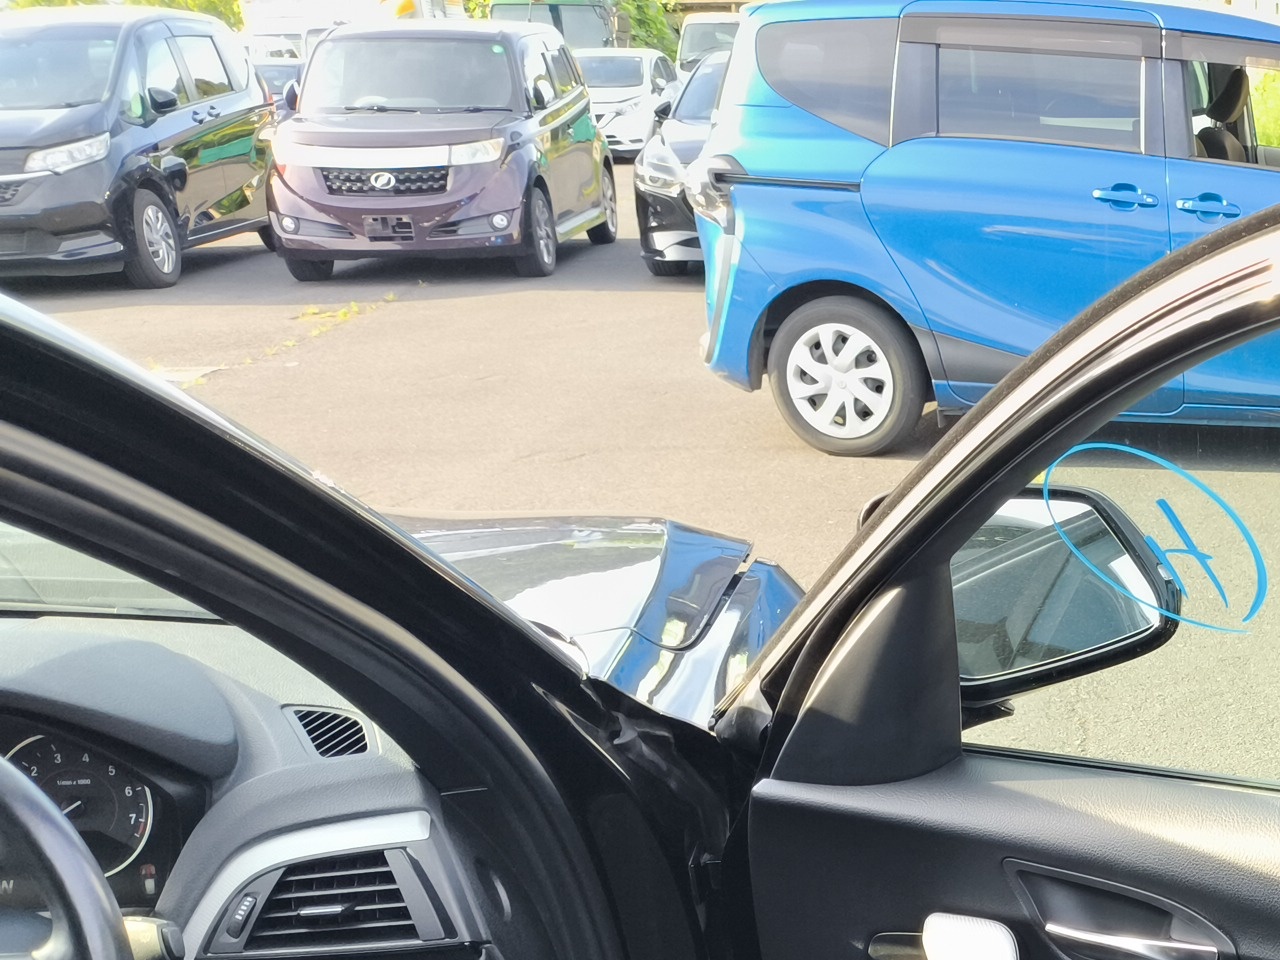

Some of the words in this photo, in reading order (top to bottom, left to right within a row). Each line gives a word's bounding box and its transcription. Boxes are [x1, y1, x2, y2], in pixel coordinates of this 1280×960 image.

[53, 753, 62, 764] 3
[82, 753, 90, 763] 4
[30, 765, 38, 777] 2
[108, 765, 116, 776] 5
[124, 785, 133, 797] 6
[128, 813, 137, 825] 7
